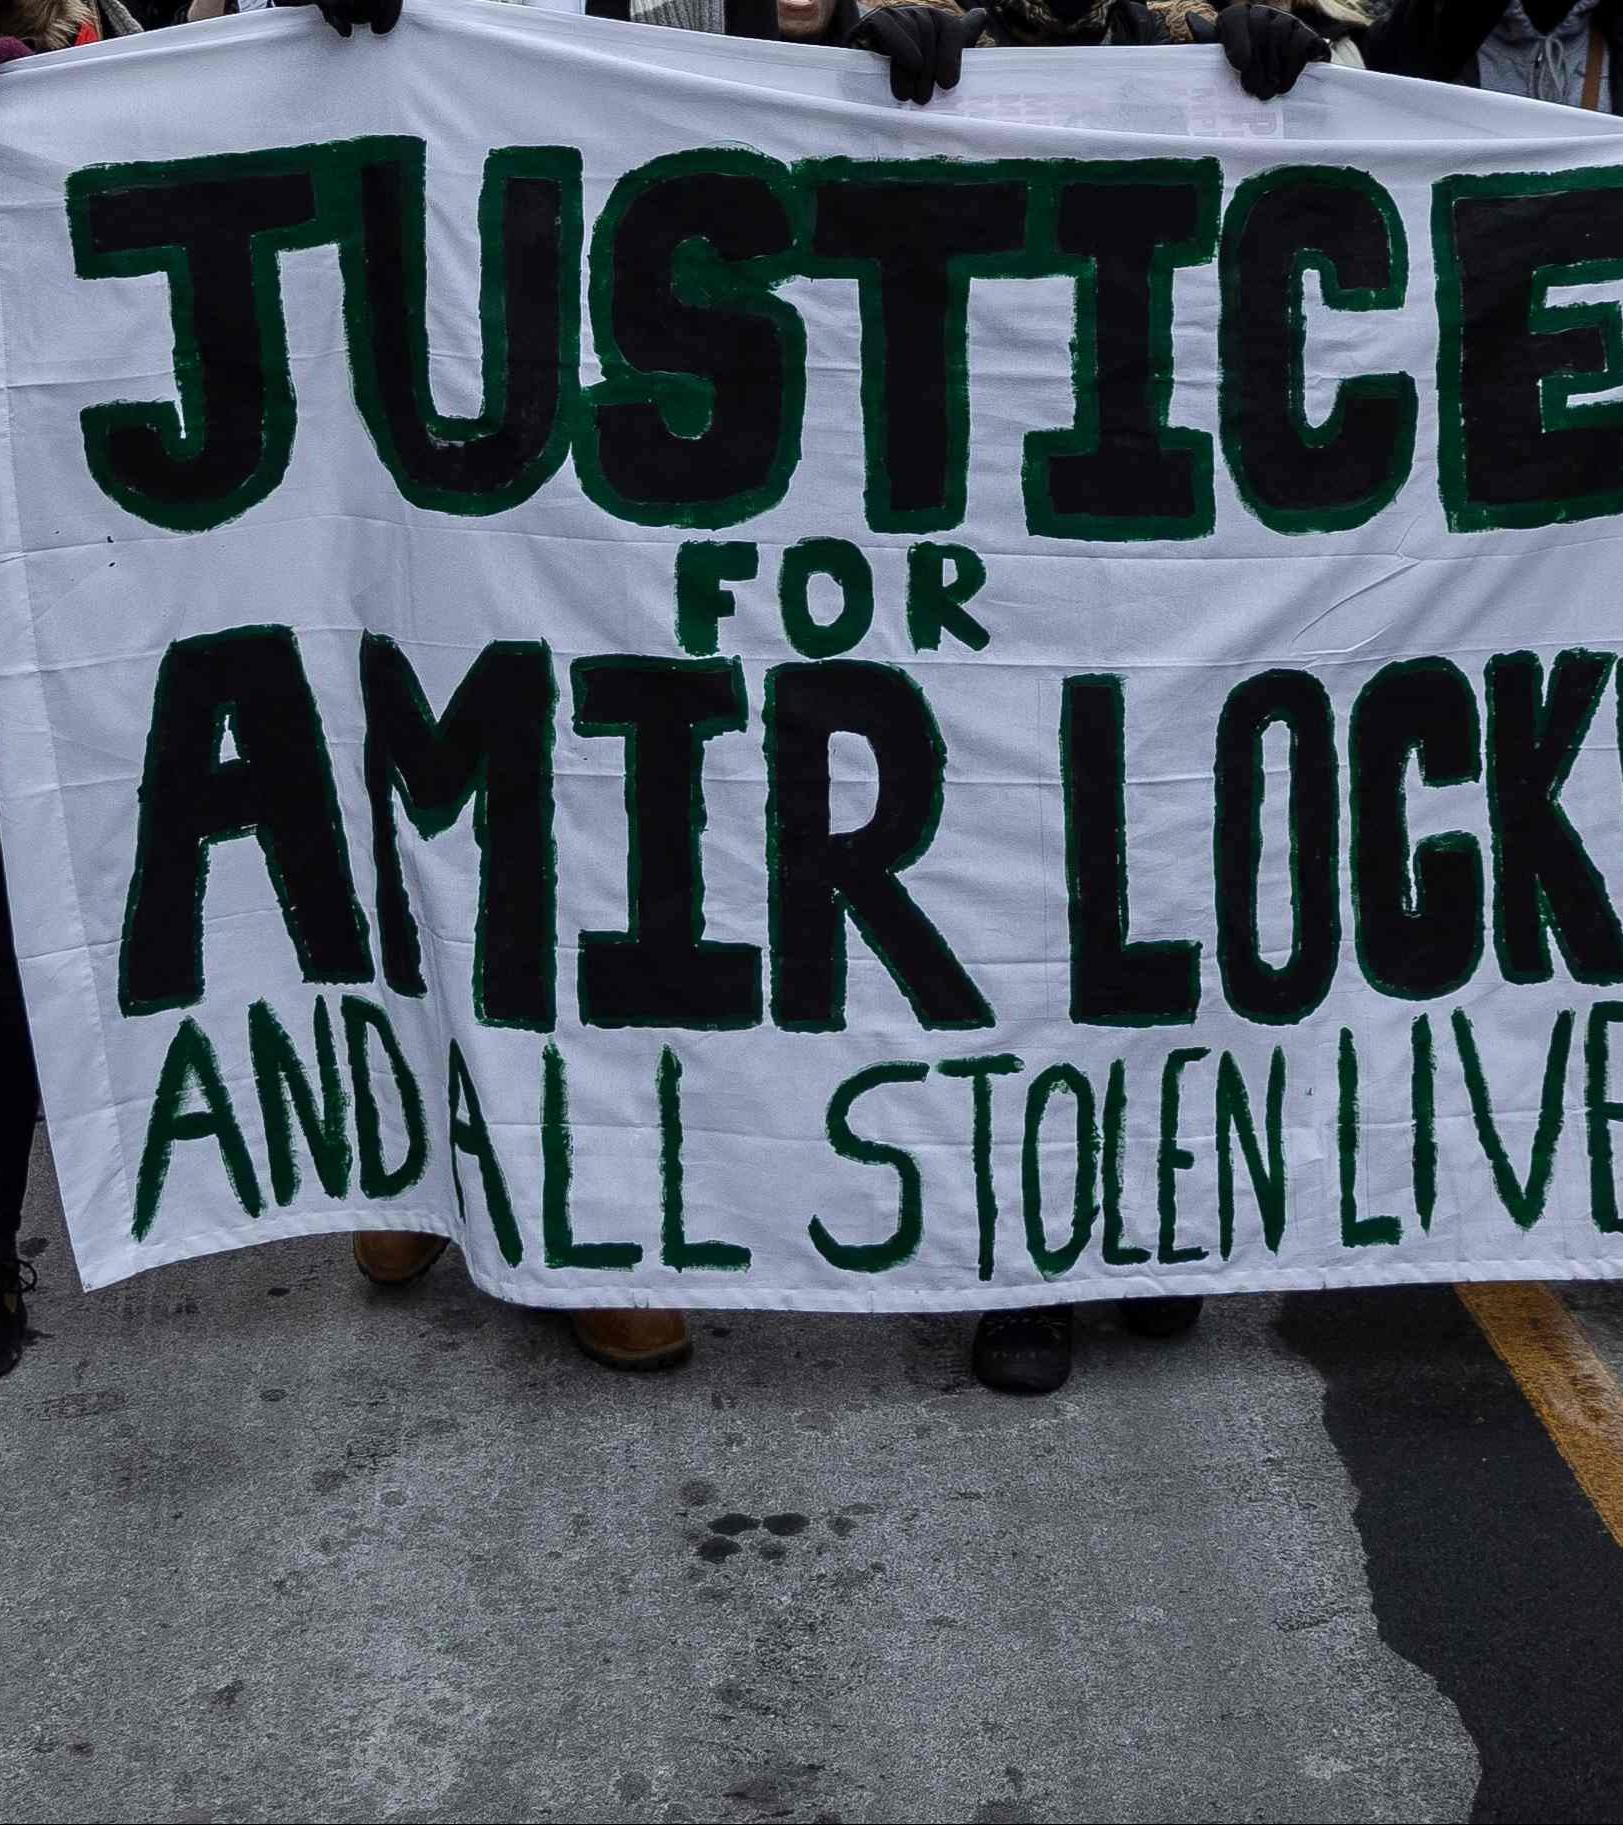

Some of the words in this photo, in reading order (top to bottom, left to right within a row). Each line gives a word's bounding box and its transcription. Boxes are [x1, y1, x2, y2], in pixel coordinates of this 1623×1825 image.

[675, 537, 990, 658] FOR
[118, 624, 995, 1034] AMIR
[132, 991, 433, 1243] AND
[446, 1044, 751, 1271] ALL
[808, 1045, 1287, 1279] STOLEN
